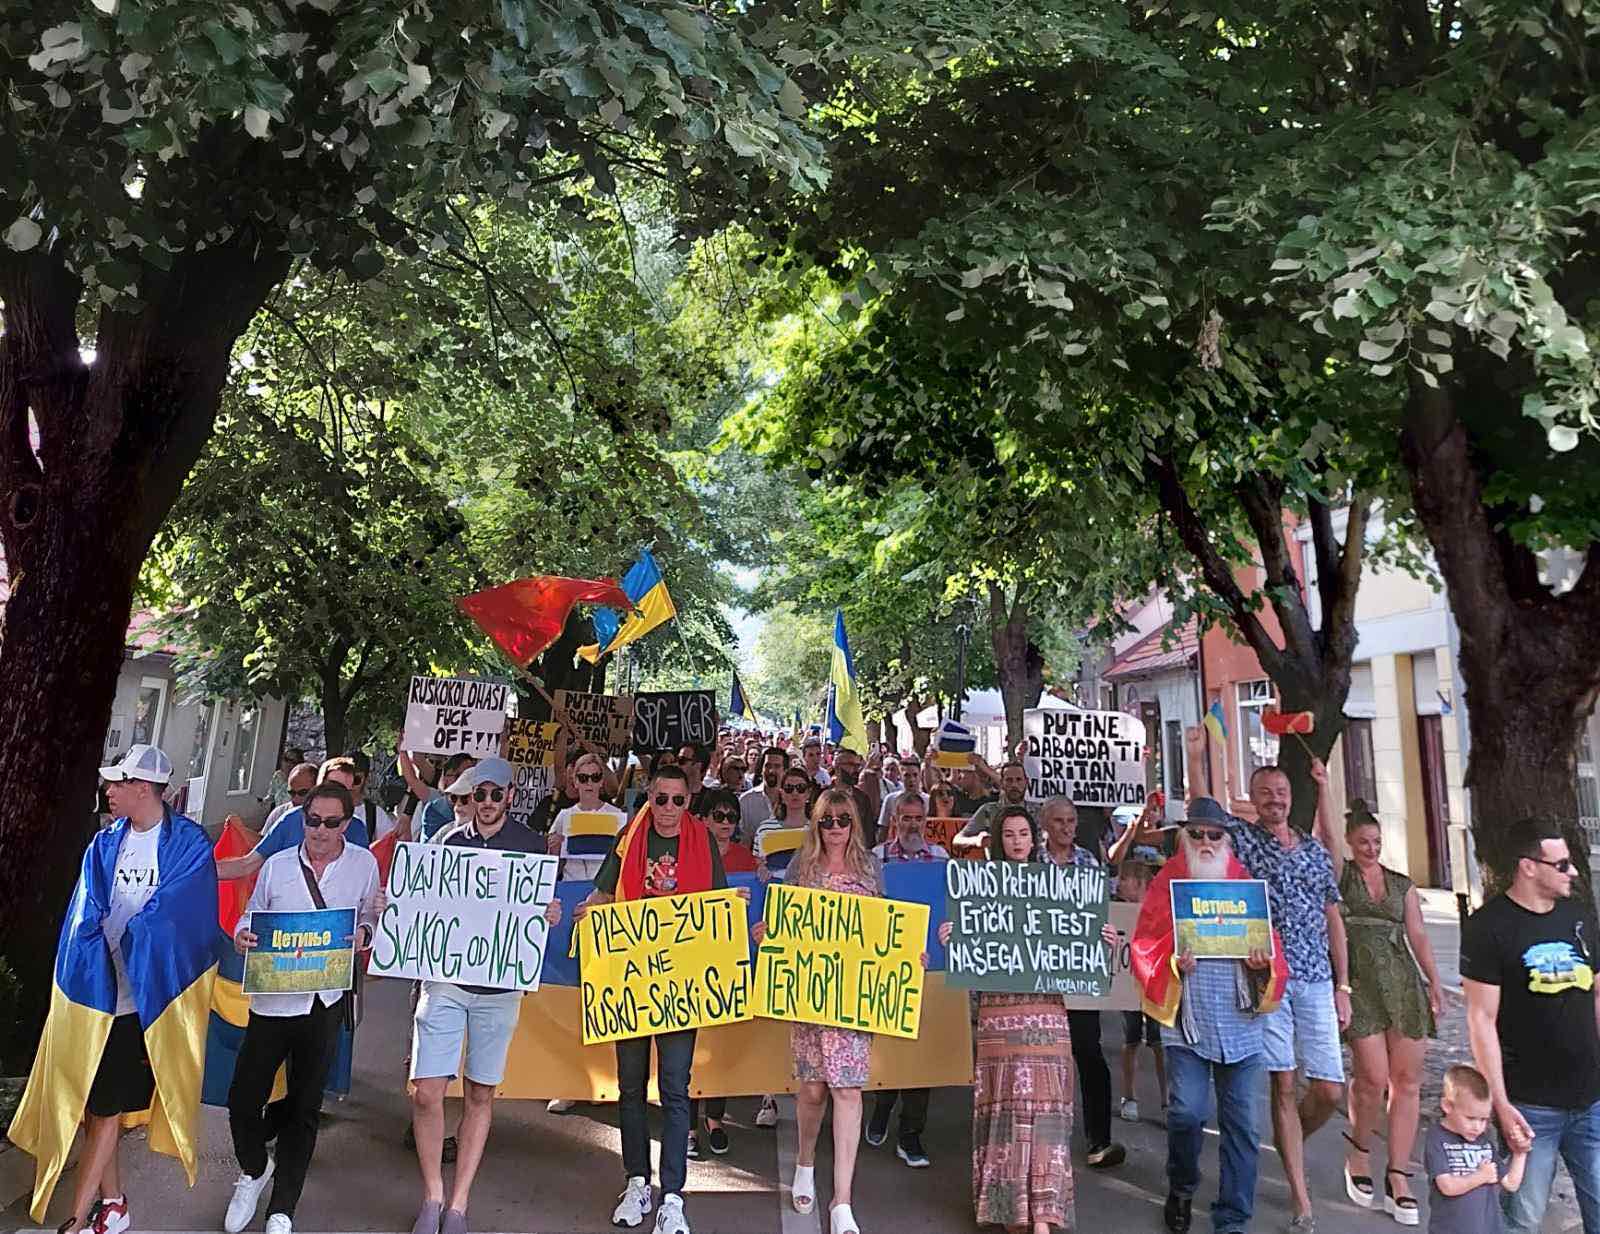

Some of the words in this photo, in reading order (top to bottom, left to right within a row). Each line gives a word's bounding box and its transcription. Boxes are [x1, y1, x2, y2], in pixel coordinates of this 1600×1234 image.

[436, 708, 472, 727] FUCK
[1043, 712, 1119, 738] PUTINE
[1028, 735, 1109, 760] DABOGDA
[1113, 741, 1140, 762] TI
[517, 766, 548, 787] OPEN
[1041, 759, 1116, 781] DRITAN
[1027, 778, 1066, 798] VLADU
[438, 848, 479, 899] RAT
[475, 866, 498, 899] SE
[946, 859, 998, 899] ODNOS
[1002, 863, 1050, 898] PREMA
[1191, 897, 1248, 916] Цетиње
[1047, 909, 1097, 937] TEST
[272, 929, 331, 950] Цетиње
[372, 903, 463, 979] SVAKOG
[467, 936, 490, 967] OD
[488, 911, 545, 989] NAS
[624, 959, 641, 981] A
[648, 949, 674, 976] NE
[949, 937, 1024, 976] NAŠEGA
[1025, 938, 1108, 977] VREMENA
[705, 960, 751, 1018] SVET
[857, 961, 918, 1033] EVROPE
